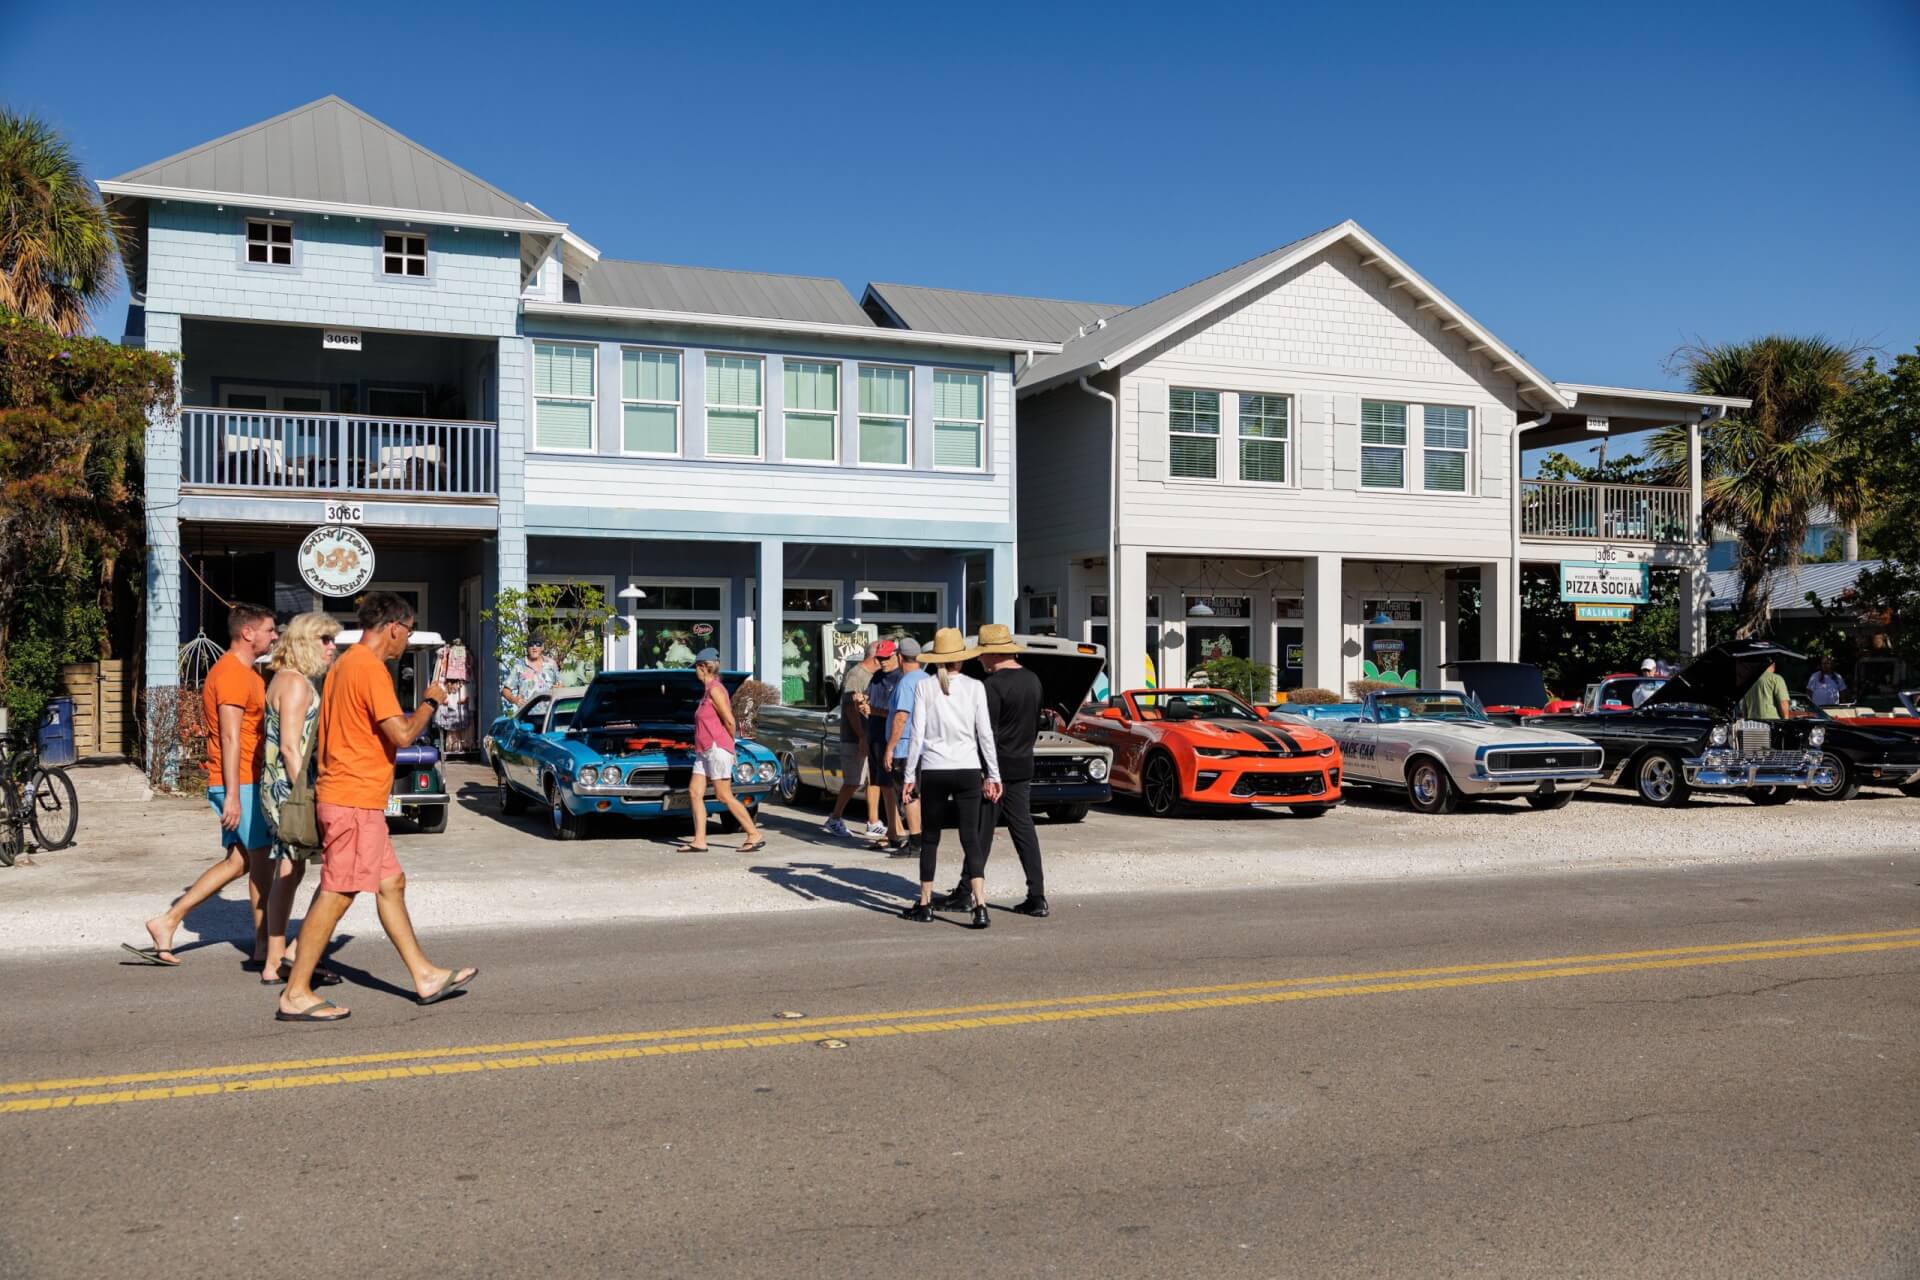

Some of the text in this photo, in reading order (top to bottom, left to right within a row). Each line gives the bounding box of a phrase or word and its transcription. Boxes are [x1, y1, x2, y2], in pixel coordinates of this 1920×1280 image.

[327, 335, 358, 344] 306R
[328, 507, 360, 520] 306C
[1598, 551, 1616, 560] 308C
[304, 567, 368, 593] EMPORIUM
[1566, 581, 1642, 595] PIZZA SOCIAL
[1578, 607, 1613, 617] ITALIAN
[1360, 744, 1376, 760] CAR
